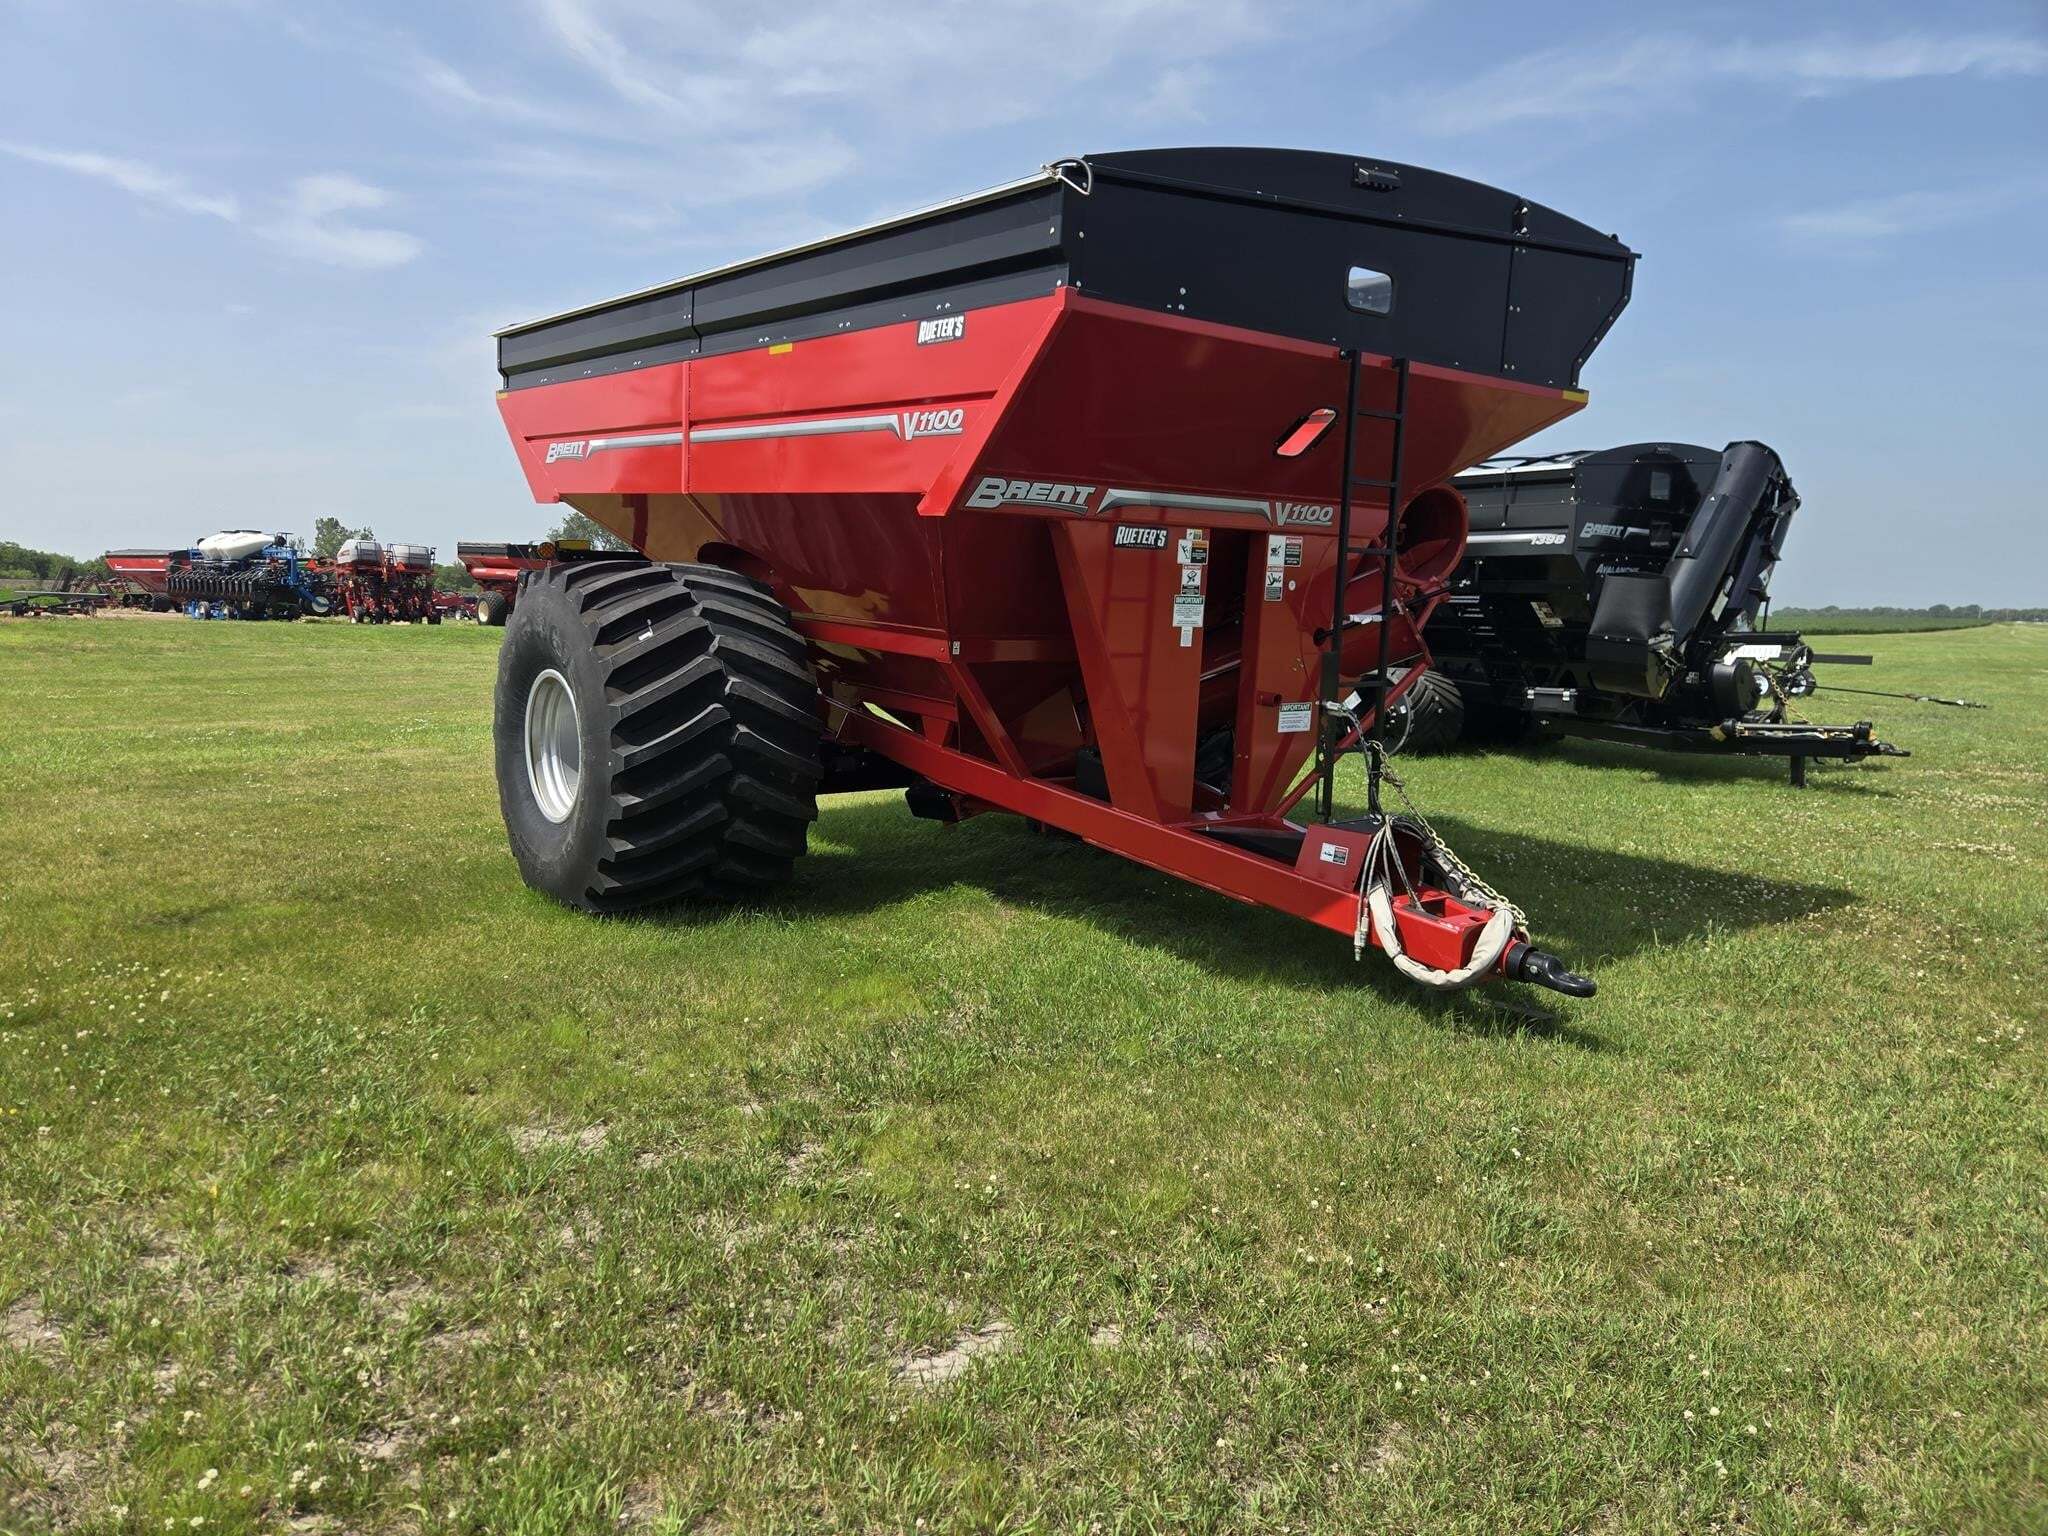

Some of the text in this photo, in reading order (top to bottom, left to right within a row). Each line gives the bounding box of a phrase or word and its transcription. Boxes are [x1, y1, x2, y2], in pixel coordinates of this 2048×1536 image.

[918, 315, 964, 344] RUETER'S
[904, 408, 964, 441] V1100
[545, 441, 585, 464] BRENT
[965, 477, 1096, 509] BRENT
[1276, 502, 1334, 526] V1100
[1115, 526, 1167, 547] RUETER'S
[1580, 522, 1624, 538] BRENT
